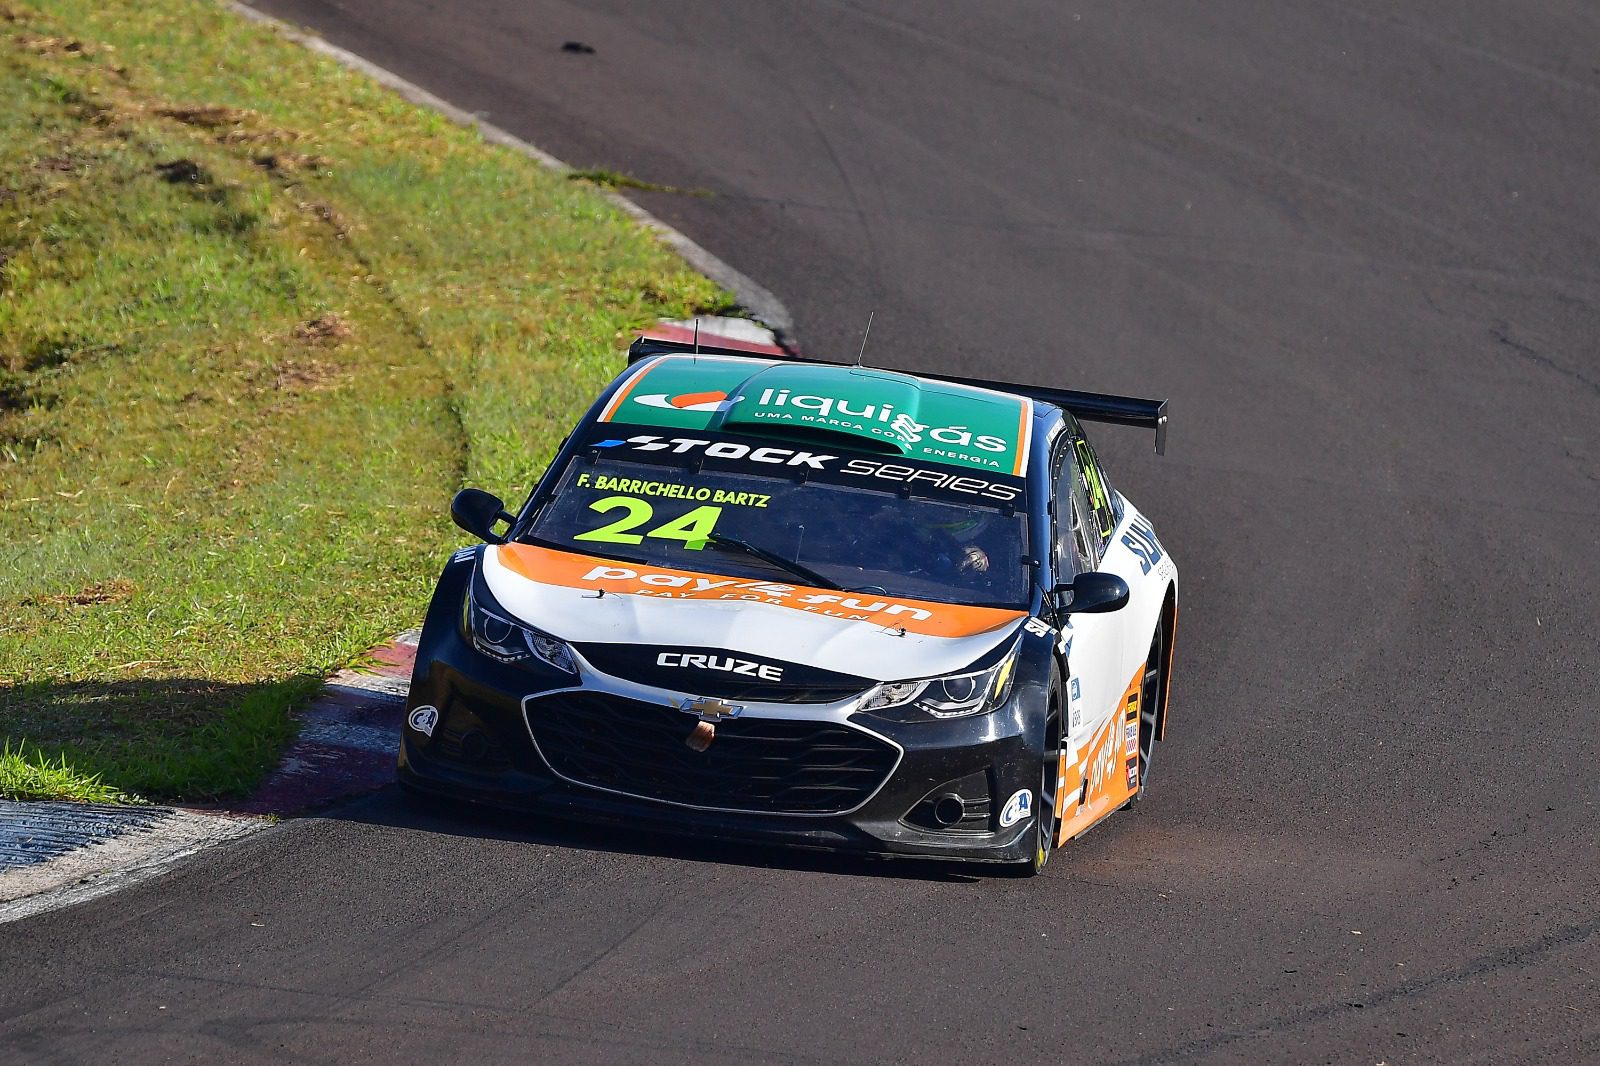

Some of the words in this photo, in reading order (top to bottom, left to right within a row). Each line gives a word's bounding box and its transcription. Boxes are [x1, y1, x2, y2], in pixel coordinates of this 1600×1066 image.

[754, 412, 793, 420] UMA
[801, 415, 864, 431] MARCA
[923, 447, 1000, 468] ENERGIA
[758, 388, 1008, 452] liquigás
[576, 473, 590, 489] F.
[595, 475, 711, 501] BARRICHELLO
[712, 490, 771, 508] BARTZ
[624, 435, 839, 470] STOCK
[840, 459, 1023, 501] SERIES
[573, 496, 722, 551] 24
[720, 593, 783, 606] FOR
[803, 605, 870, 620] FUN
[656, 653, 784, 682] CRUZE
